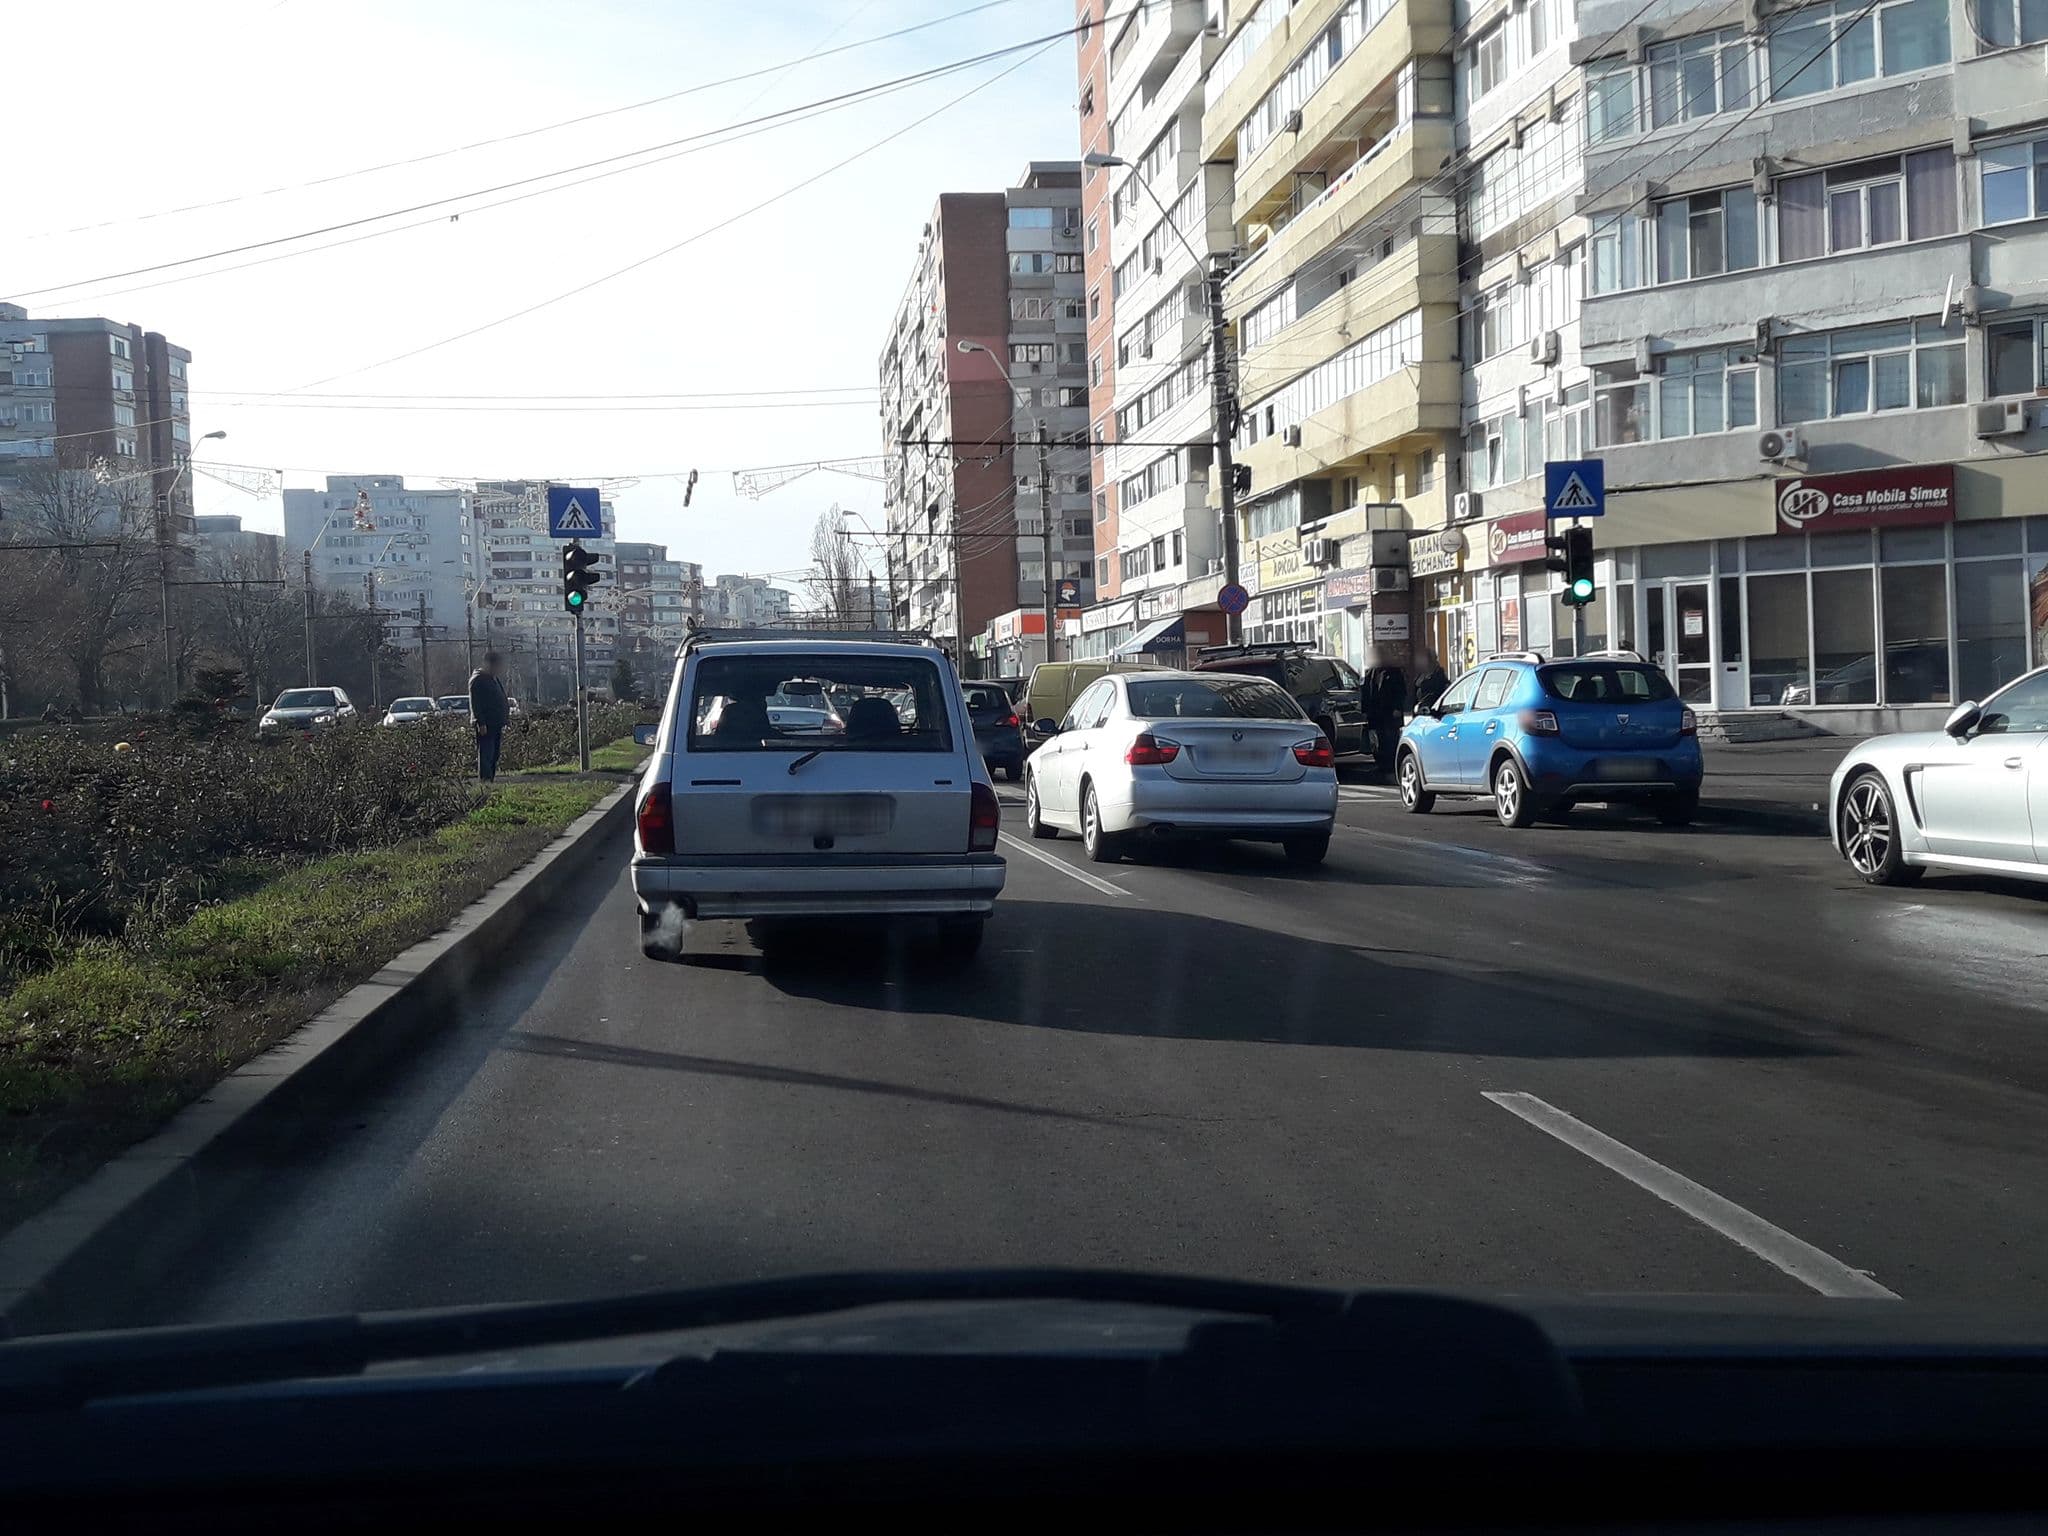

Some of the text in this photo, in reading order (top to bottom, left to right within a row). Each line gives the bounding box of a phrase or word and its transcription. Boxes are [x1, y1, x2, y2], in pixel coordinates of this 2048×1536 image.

[1833, 486, 1948, 507] Casa Mobila Simex
[1410, 552, 1456, 576] EXCHANGE
